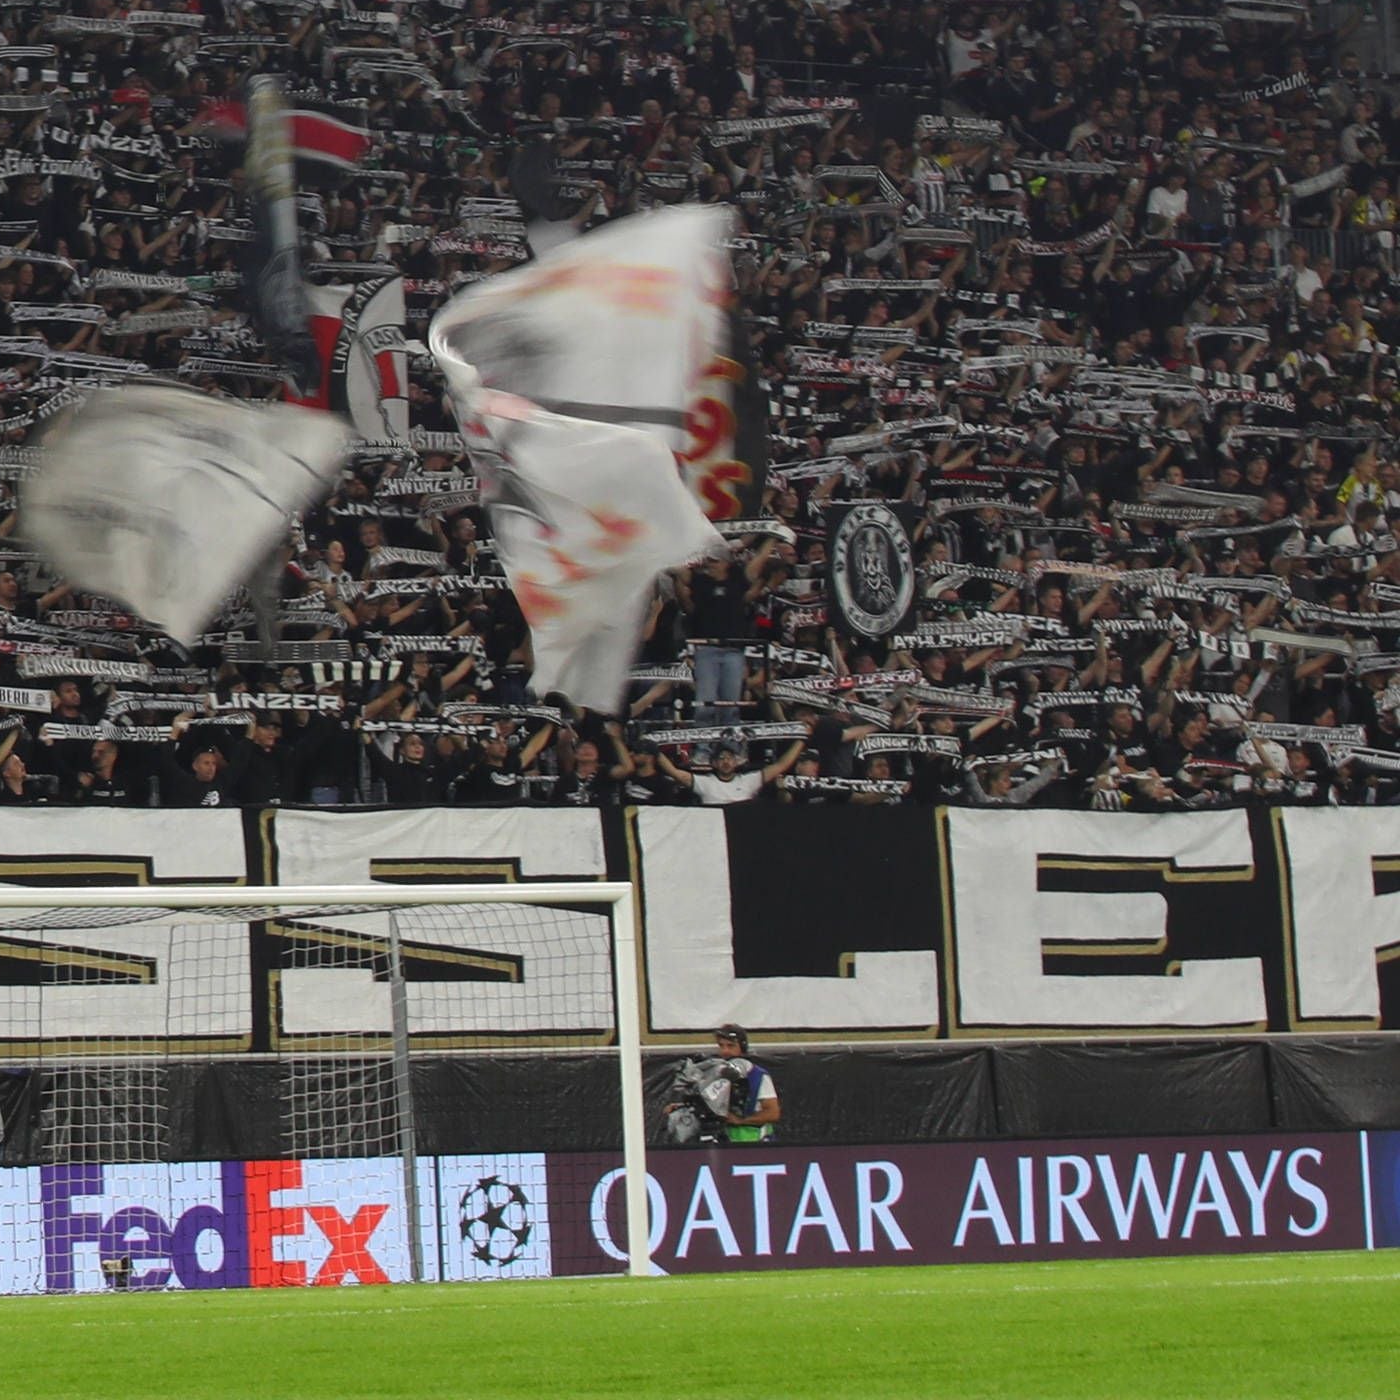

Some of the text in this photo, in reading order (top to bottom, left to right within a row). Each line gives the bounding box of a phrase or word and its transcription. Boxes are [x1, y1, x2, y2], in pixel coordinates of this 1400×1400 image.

[207, 691, 342, 711] LINZER
[41, 1160, 391, 1292] FedEx
[591, 1147, 1331, 1276] QATAR AIRWAYS
